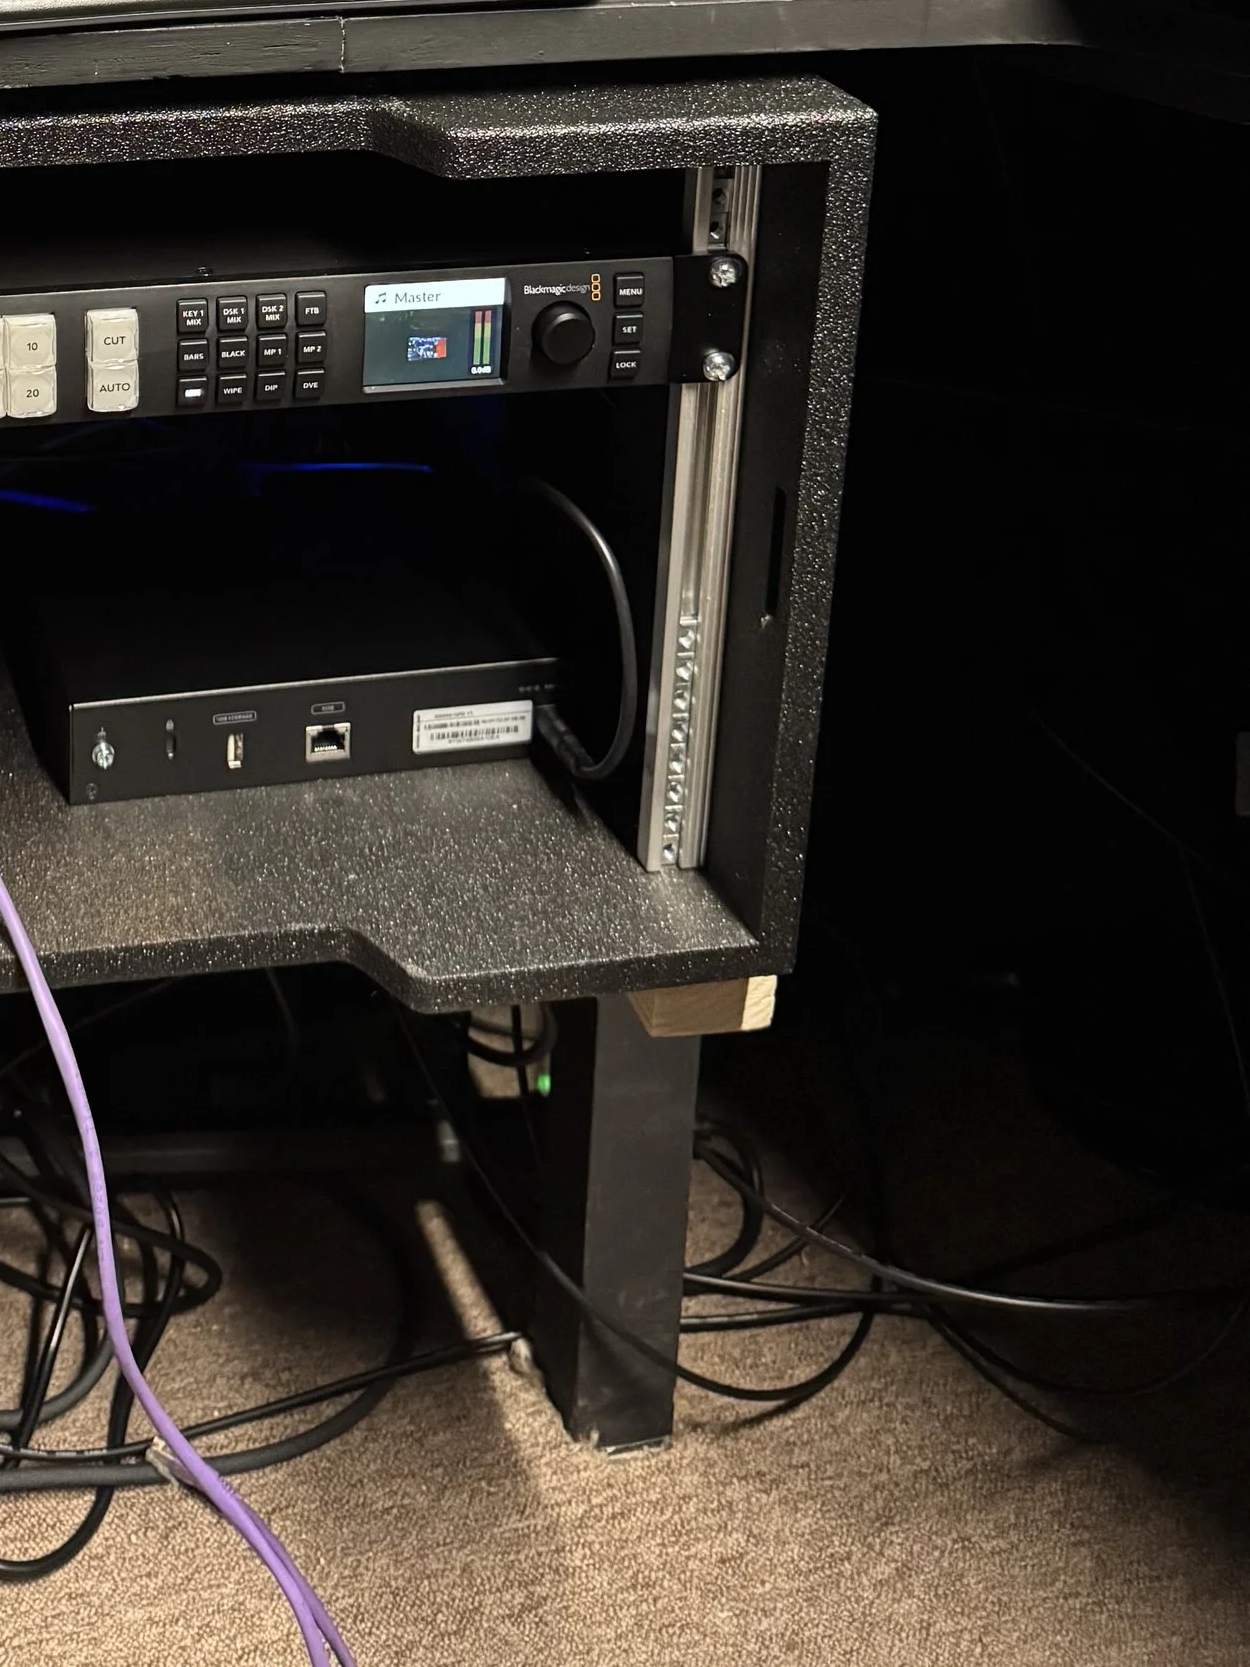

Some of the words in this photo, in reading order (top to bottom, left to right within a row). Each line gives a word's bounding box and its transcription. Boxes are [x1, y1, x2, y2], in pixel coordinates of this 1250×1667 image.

[619, 288, 642, 296] MENU
[394, 291, 441, 304] Master
[182, 309, 198, 318] KEY
[223, 308, 239, 316] DSK
[261, 305, 278, 314] DSK
[305, 307, 319, 315] FTB
[227, 315, 242, 323] MIX
[265, 313, 280, 321] MIX
[186, 318, 201, 326] MIX
[622, 326, 637, 334] SET
[103, 336, 126, 346] CUT
[26, 342, 38, 352] 10
[221, 349, 246, 358] BLACK
[264, 348, 276, 356] MP
[183, 353, 204, 361] BARS
[615, 360, 637, 369] LOCK
[99, 383, 131, 393] AUTO
[265, 384, 278, 392] DIP
[303, 381, 318, 390] DVE
[26, 388, 40, 399] 20
[223, 387, 243, 395] WIPE
